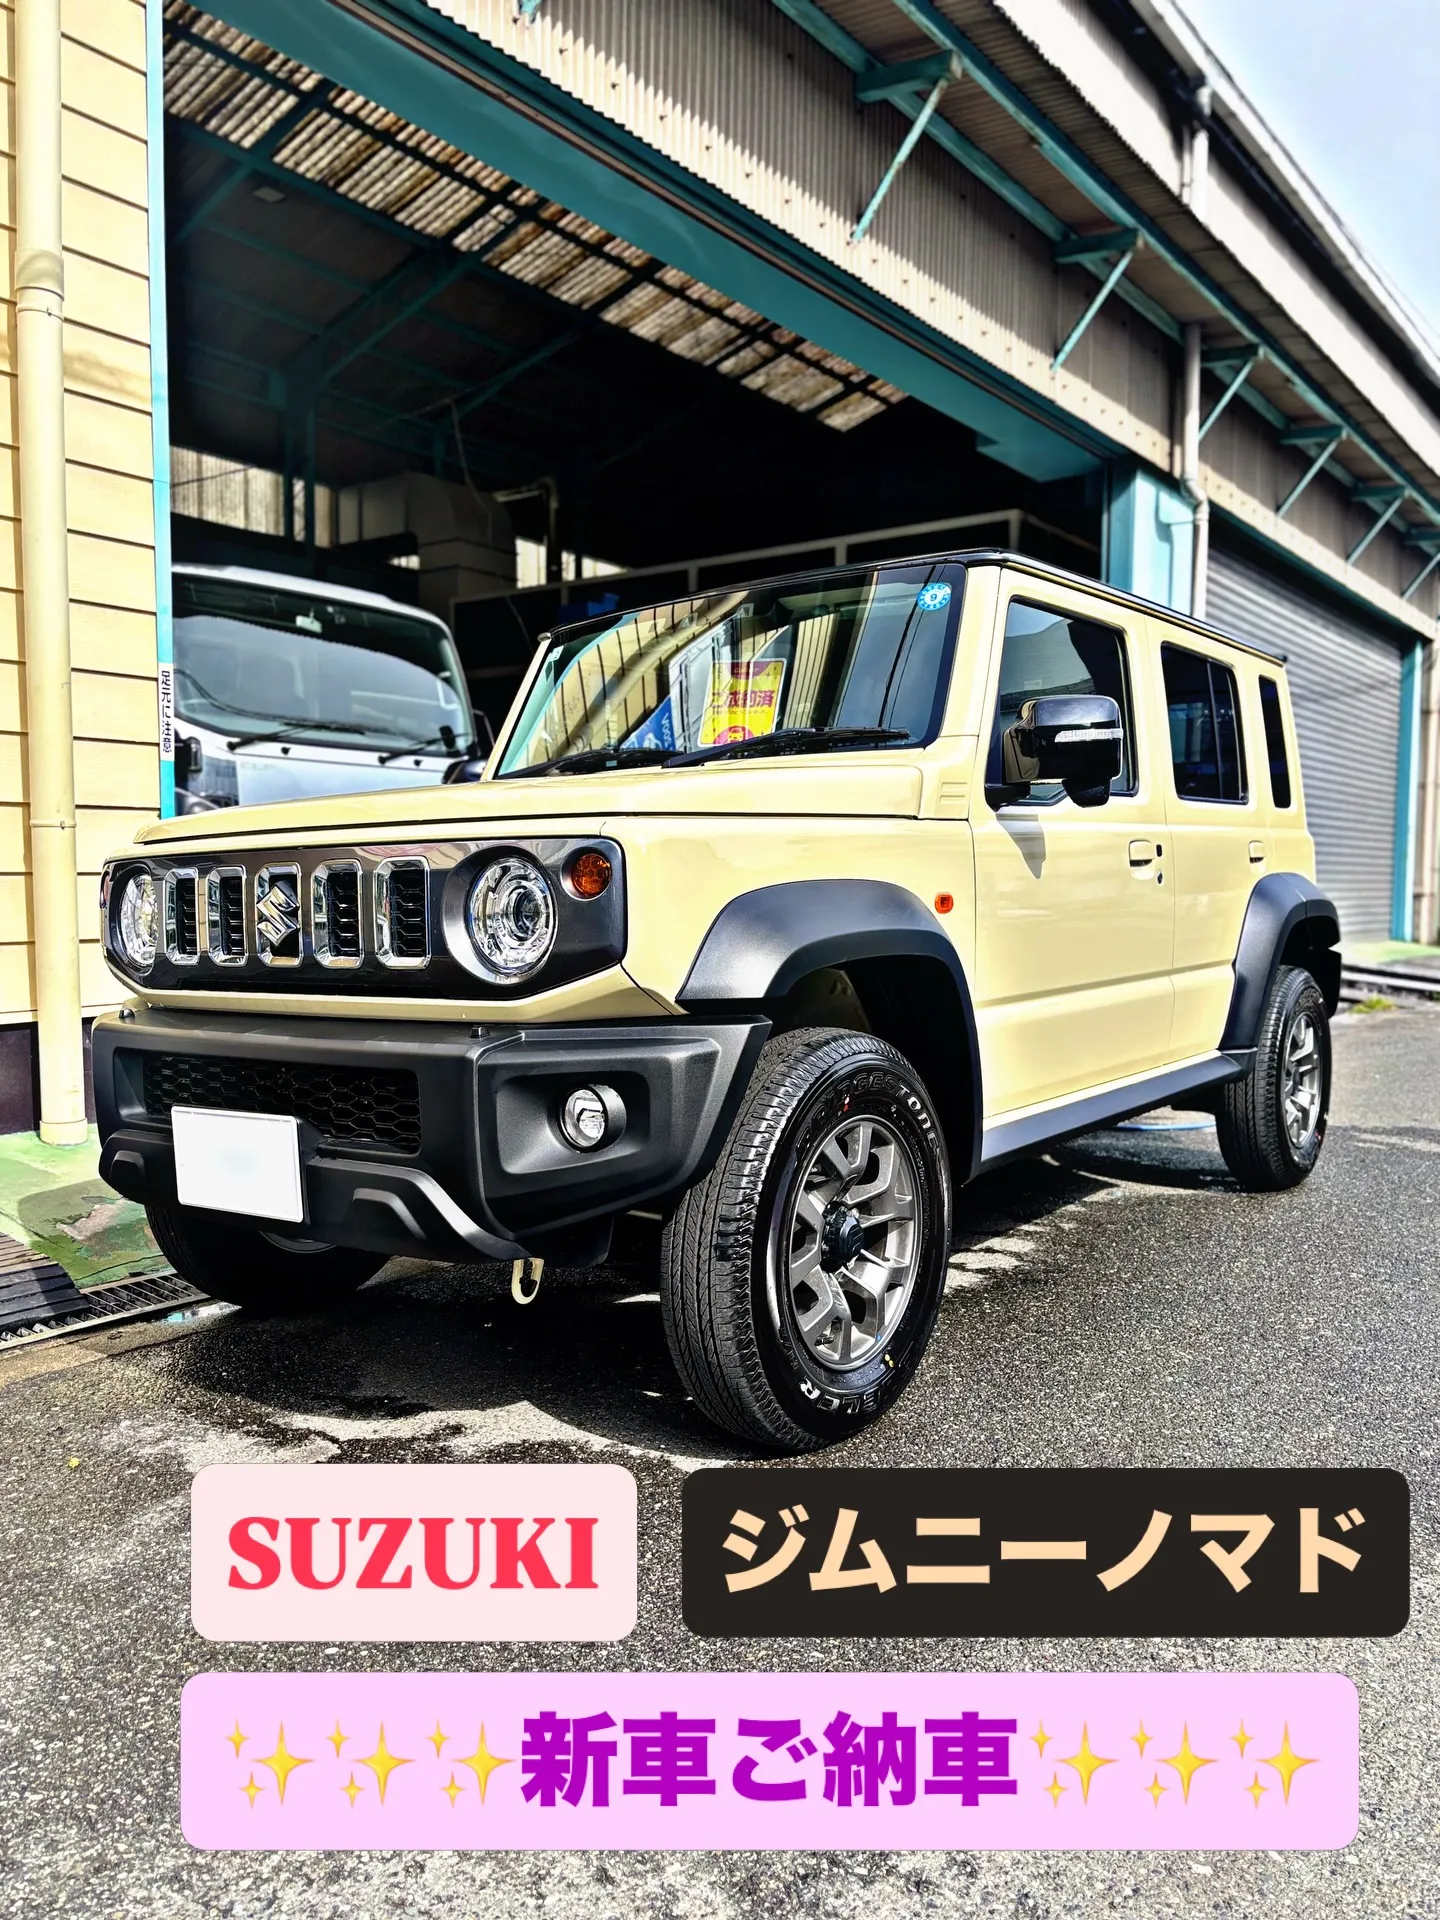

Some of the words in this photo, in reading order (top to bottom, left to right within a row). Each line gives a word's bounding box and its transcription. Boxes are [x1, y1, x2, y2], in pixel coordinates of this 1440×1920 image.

[161, 670, 173, 753] 足元に注意
